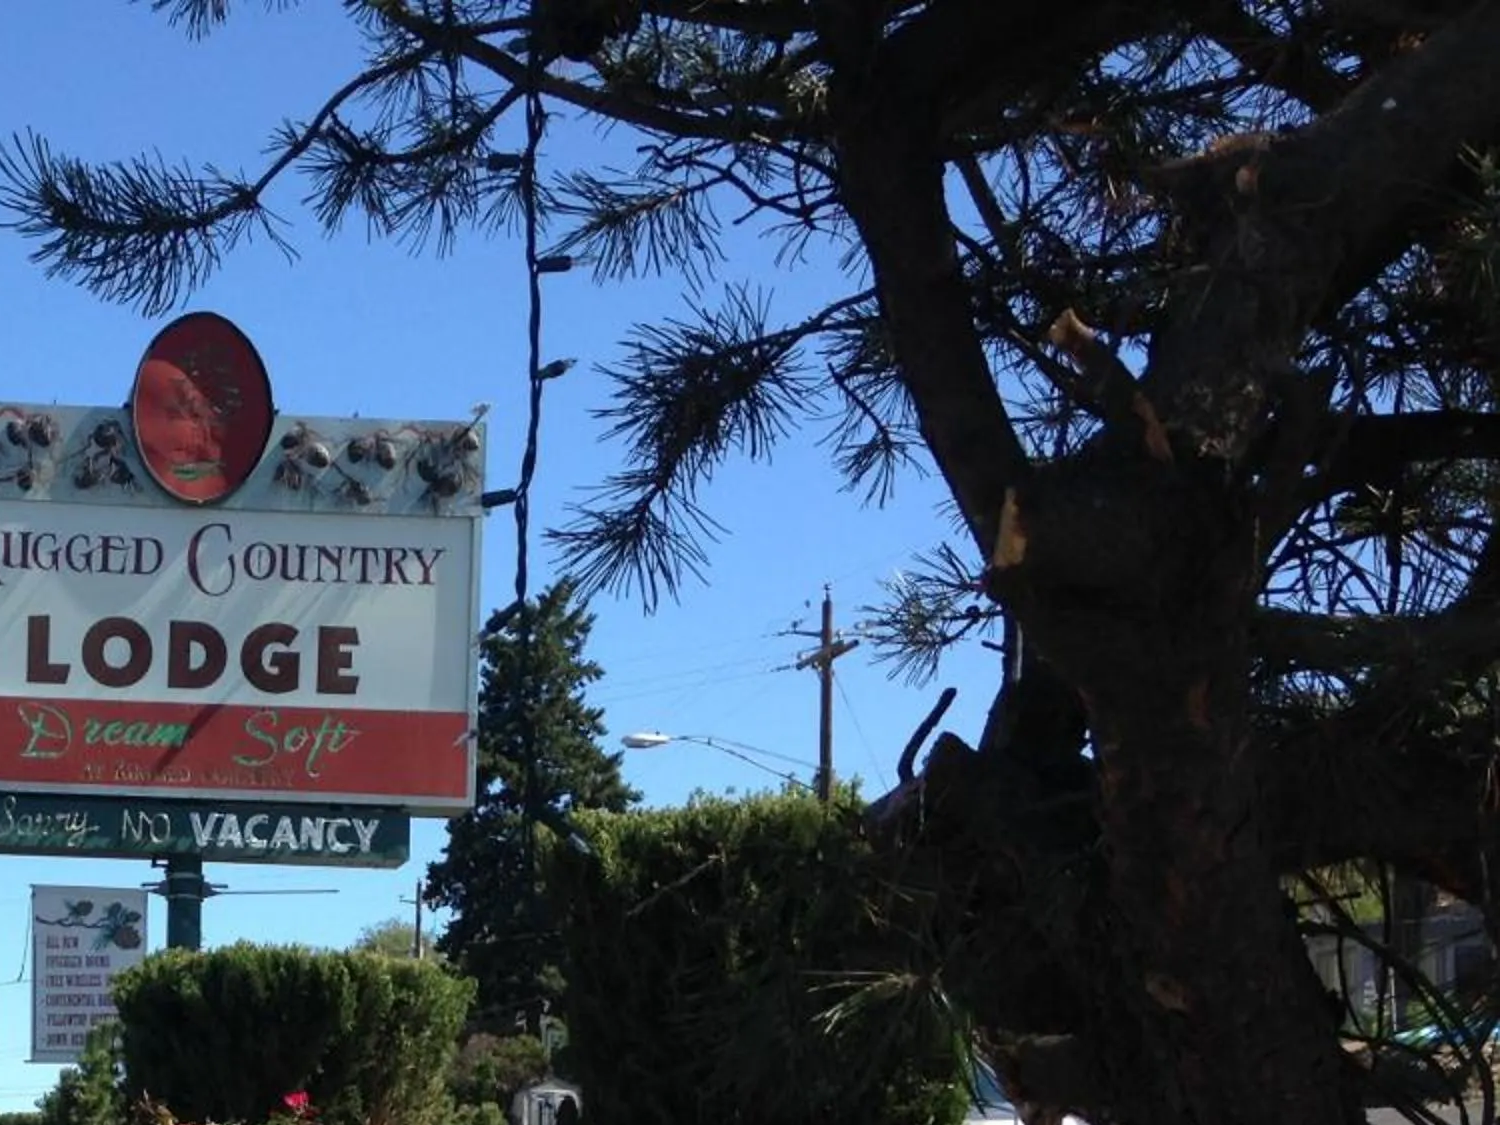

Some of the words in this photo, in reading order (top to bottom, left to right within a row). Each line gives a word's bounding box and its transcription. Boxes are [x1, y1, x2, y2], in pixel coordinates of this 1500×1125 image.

[188, 523, 446, 597] COUNTRY
[26, 615, 361, 694] LODGE
[17, 701, 194, 758] Dream
[232, 711, 363, 777] Soft
[121, 808, 171, 844] NO
[188, 811, 380, 854] VACANCY
